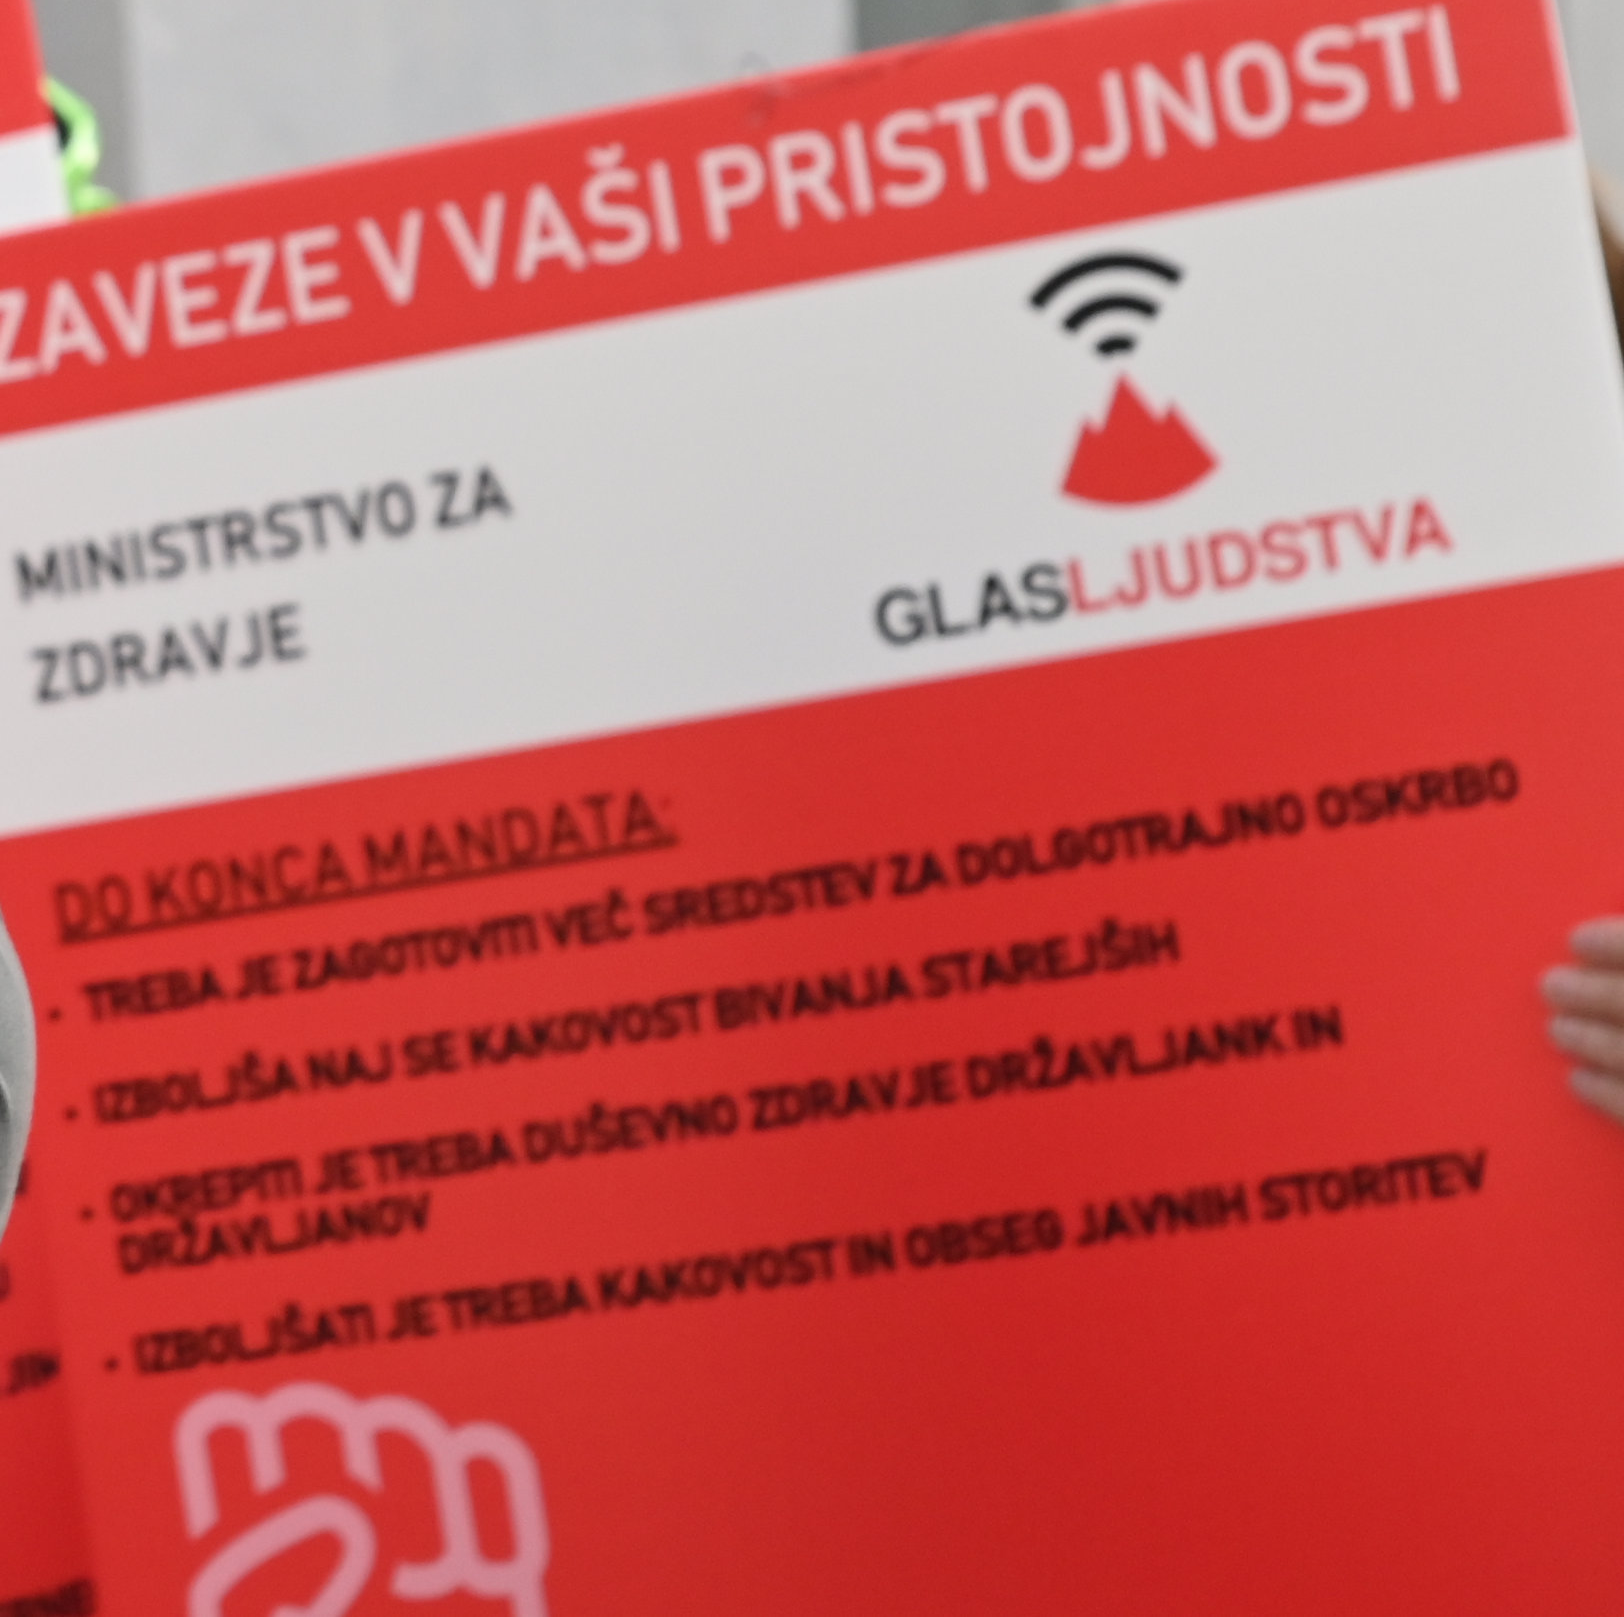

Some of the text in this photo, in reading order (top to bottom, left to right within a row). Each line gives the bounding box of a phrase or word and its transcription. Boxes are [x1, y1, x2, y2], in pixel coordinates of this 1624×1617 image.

[358, 209, 424, 306] V
[438, 142, 682, 291] VAŠI
[697, 4, 1462, 244] PRISTOJNOSTI
[14, 465, 513, 606] MINISTRSTVO ZA
[30, 602, 309, 705] ZDRAVJE
[54, 790, 677, 934] DO KONCA MANDATA:
[83, 756, 1522, 1023] TREBA JE ZAGOTOVITI VEČ SREDSTEV ZA DOLGOTRAJNO OSKRBO
[94, 916, 1182, 1126] IZBOLJŠA NAJ SE KAKOVOST BIVANJA STAREJŠIH
[109, 1005, 1346, 1224] OKREPITI JE TREBA DUŠEVNO ZDRAVJE DRŽAVLJANK IN
[119, 1192, 434, 1275] DRŽAVLJANOV
[135, 1148, 1491, 1376] IZBOLJŠATI JE TREBA KAKOVOST IN OBSEG JAVNIH STORITEV
